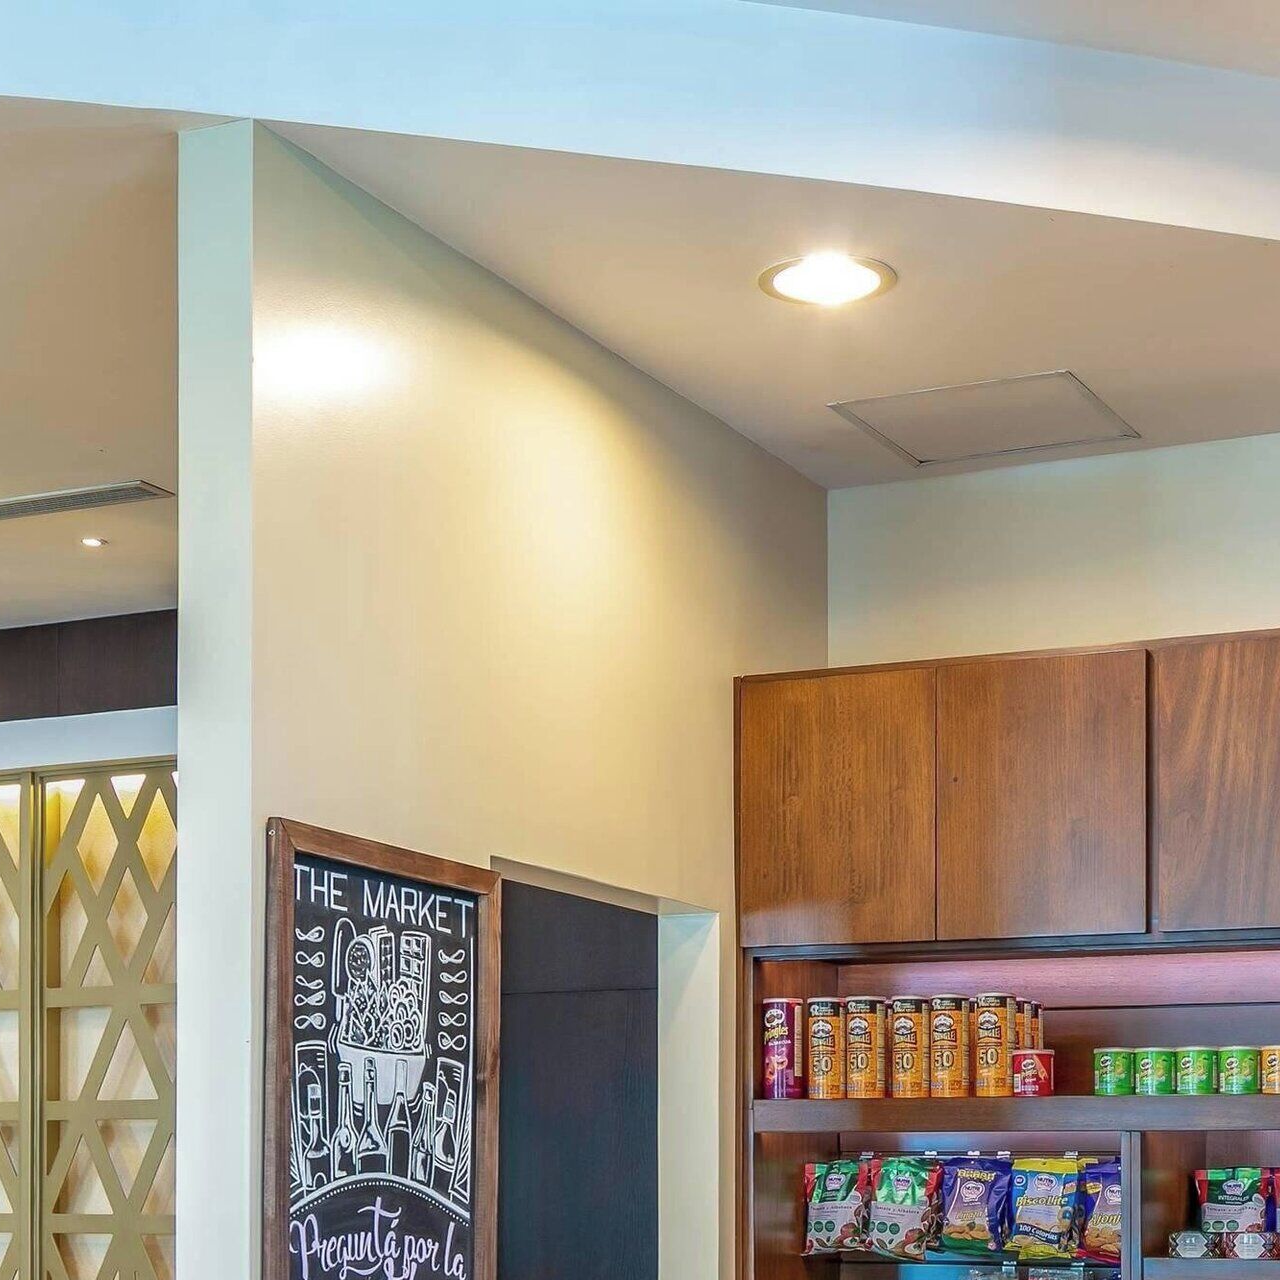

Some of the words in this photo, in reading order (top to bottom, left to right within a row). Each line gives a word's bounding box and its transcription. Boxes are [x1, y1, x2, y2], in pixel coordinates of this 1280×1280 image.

[293, 863, 348, 912] THE
[363, 879, 474, 939] MARKET
[813, 1056, 832, 1073] 50
[850, 1052, 868, 1069] 50
[895, 1052, 915, 1070] 50
[935, 1051, 954, 1067] 50
[979, 1048, 999, 1064] 50
[289, 1196, 402, 1280] Preguntá
[403, 1234, 440, 1279] por
[444, 1221, 466, 1280] la
